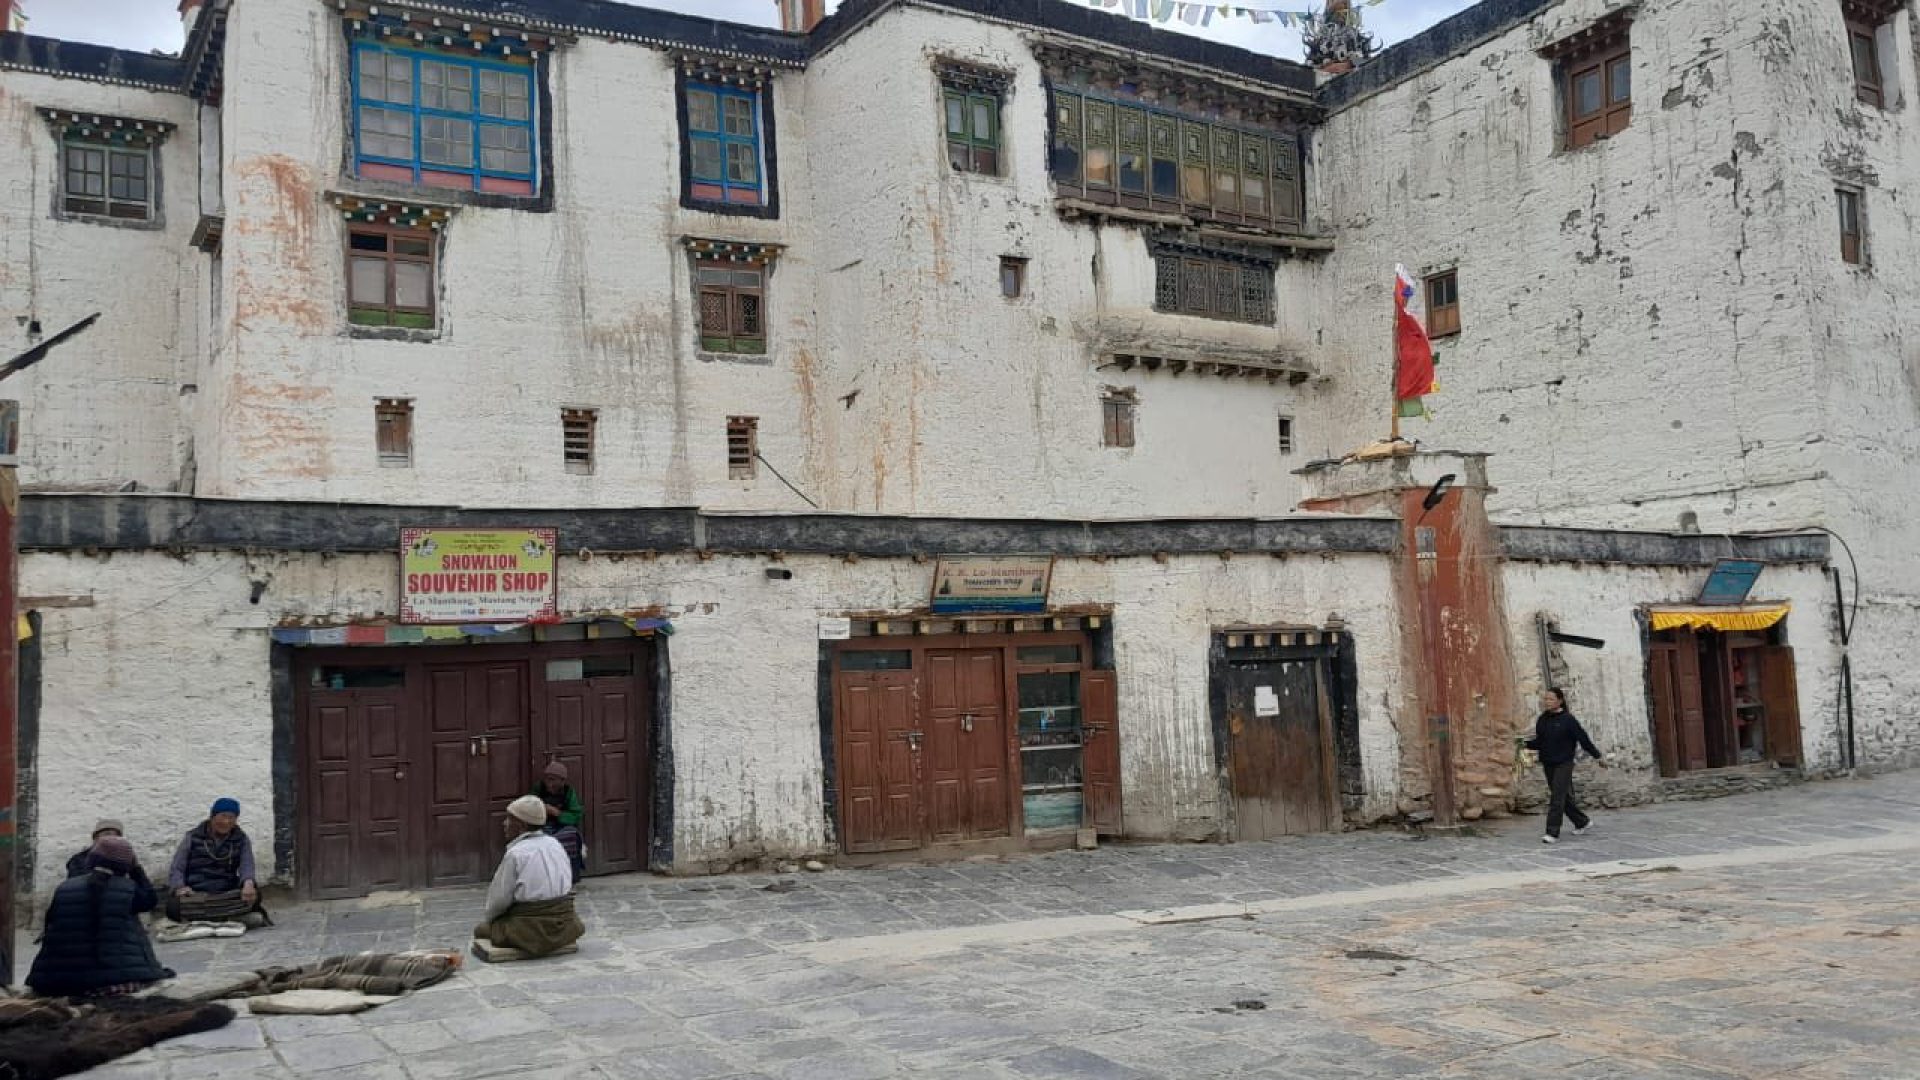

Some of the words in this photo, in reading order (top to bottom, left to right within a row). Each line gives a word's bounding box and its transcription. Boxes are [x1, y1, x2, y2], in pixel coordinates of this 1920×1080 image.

[442, 554, 517, 570] SNOWLION
[407, 573, 497, 593] SOUVENIR
[502, 572, 549, 591] SHOP
